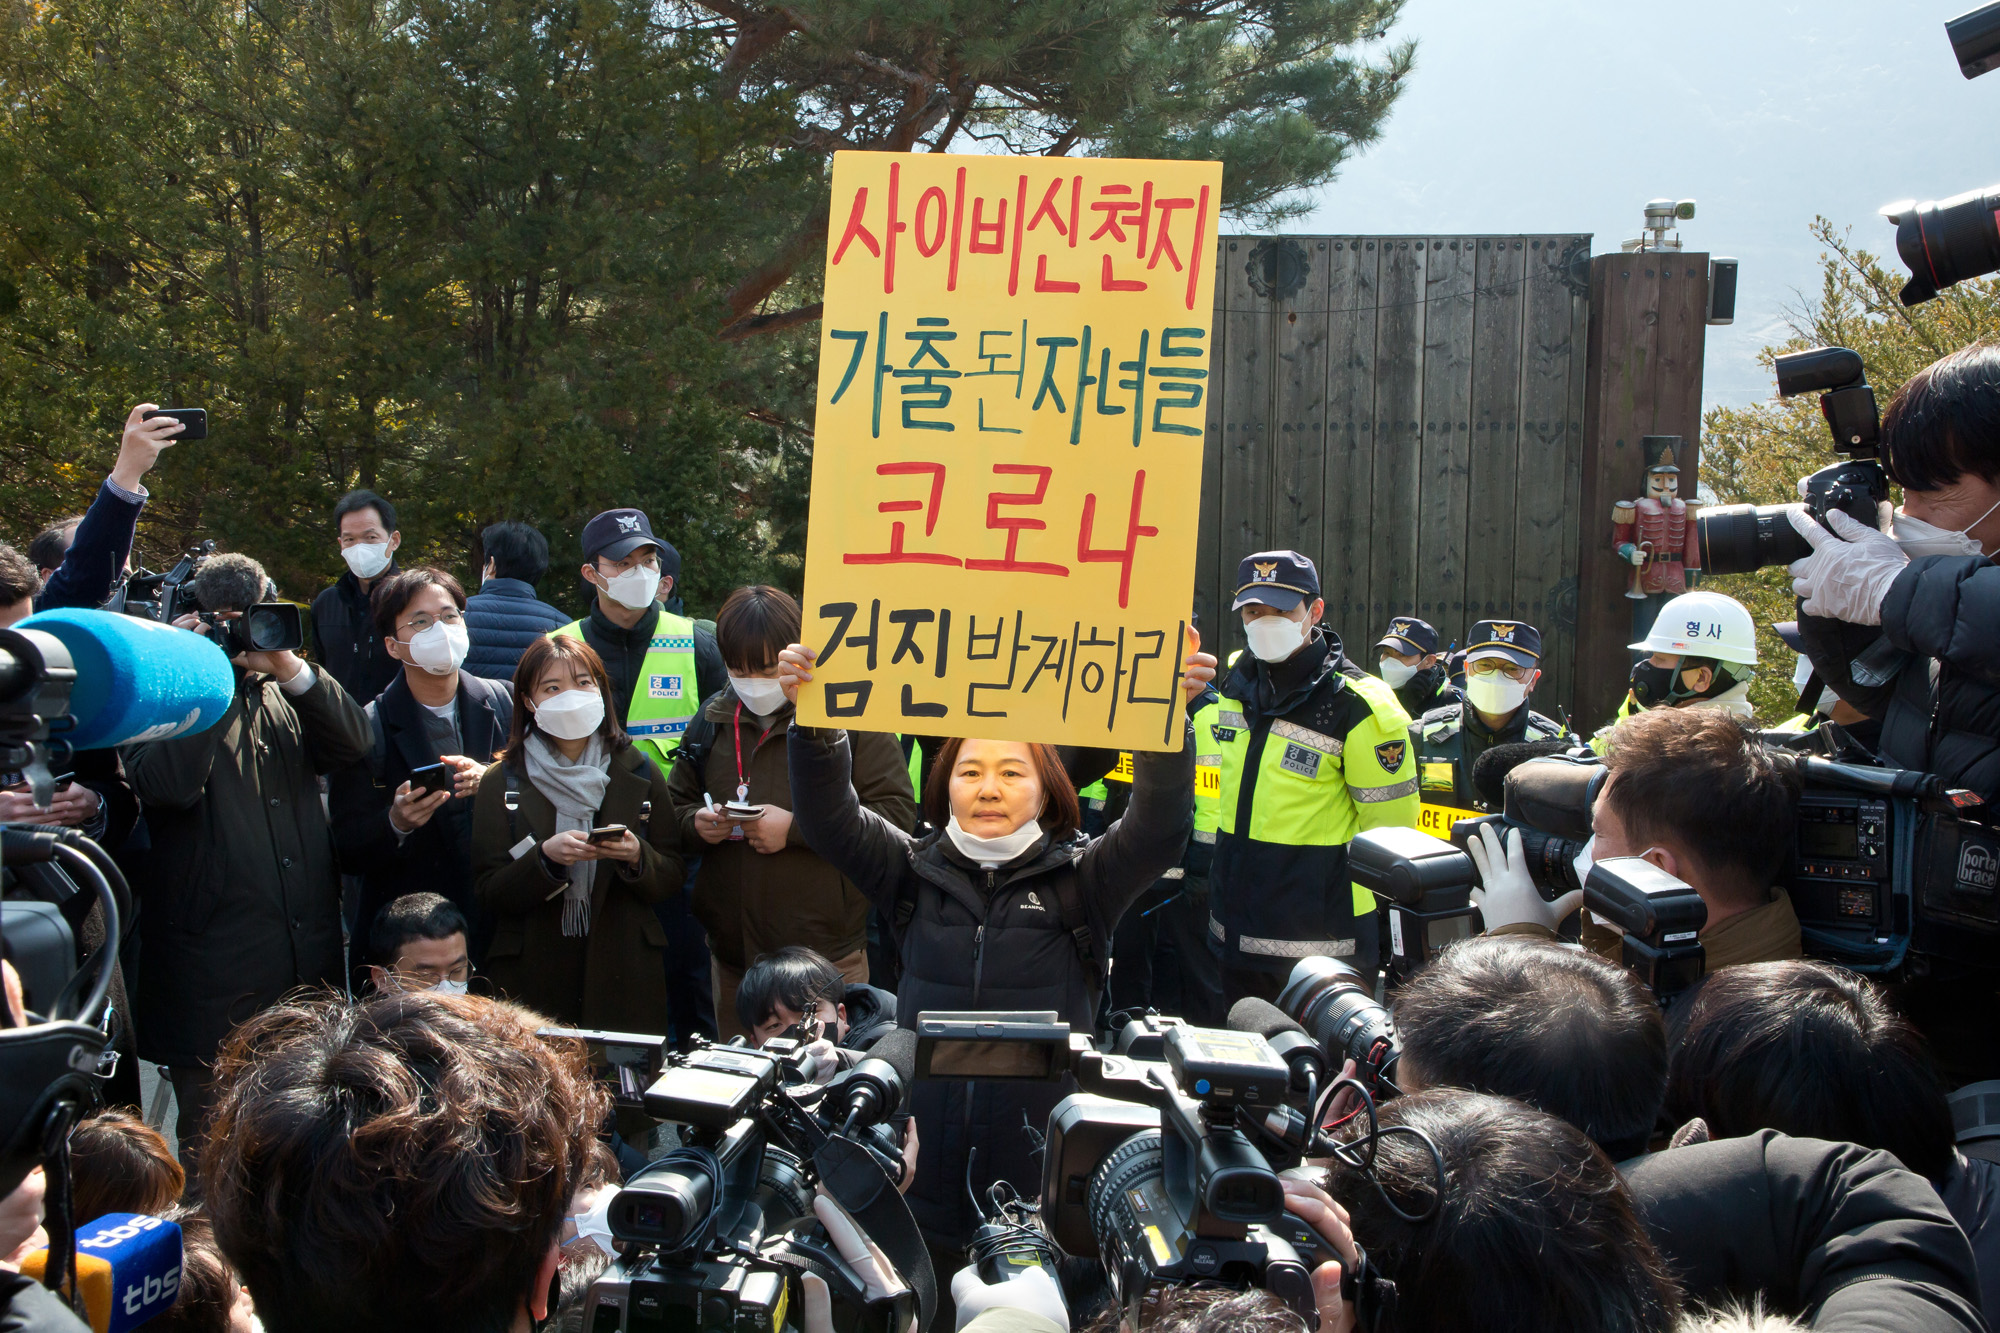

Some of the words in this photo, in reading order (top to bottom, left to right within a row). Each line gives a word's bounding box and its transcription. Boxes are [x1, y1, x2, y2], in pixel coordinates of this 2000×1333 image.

[830, 311, 1208, 448] 가출된자녀들
[842, 461, 1159, 609] 코로나
[1686, 621, 1722, 640] 형사
[652, 677, 679, 689] 경찰
[1289, 746, 1318, 766] 경찰
[1284, 759, 1314, 775] POLICE
[1961, 868, 1995, 886] brace
[79, 1214, 163, 1248] tbs
[122, 1265, 180, 1316] tbs
